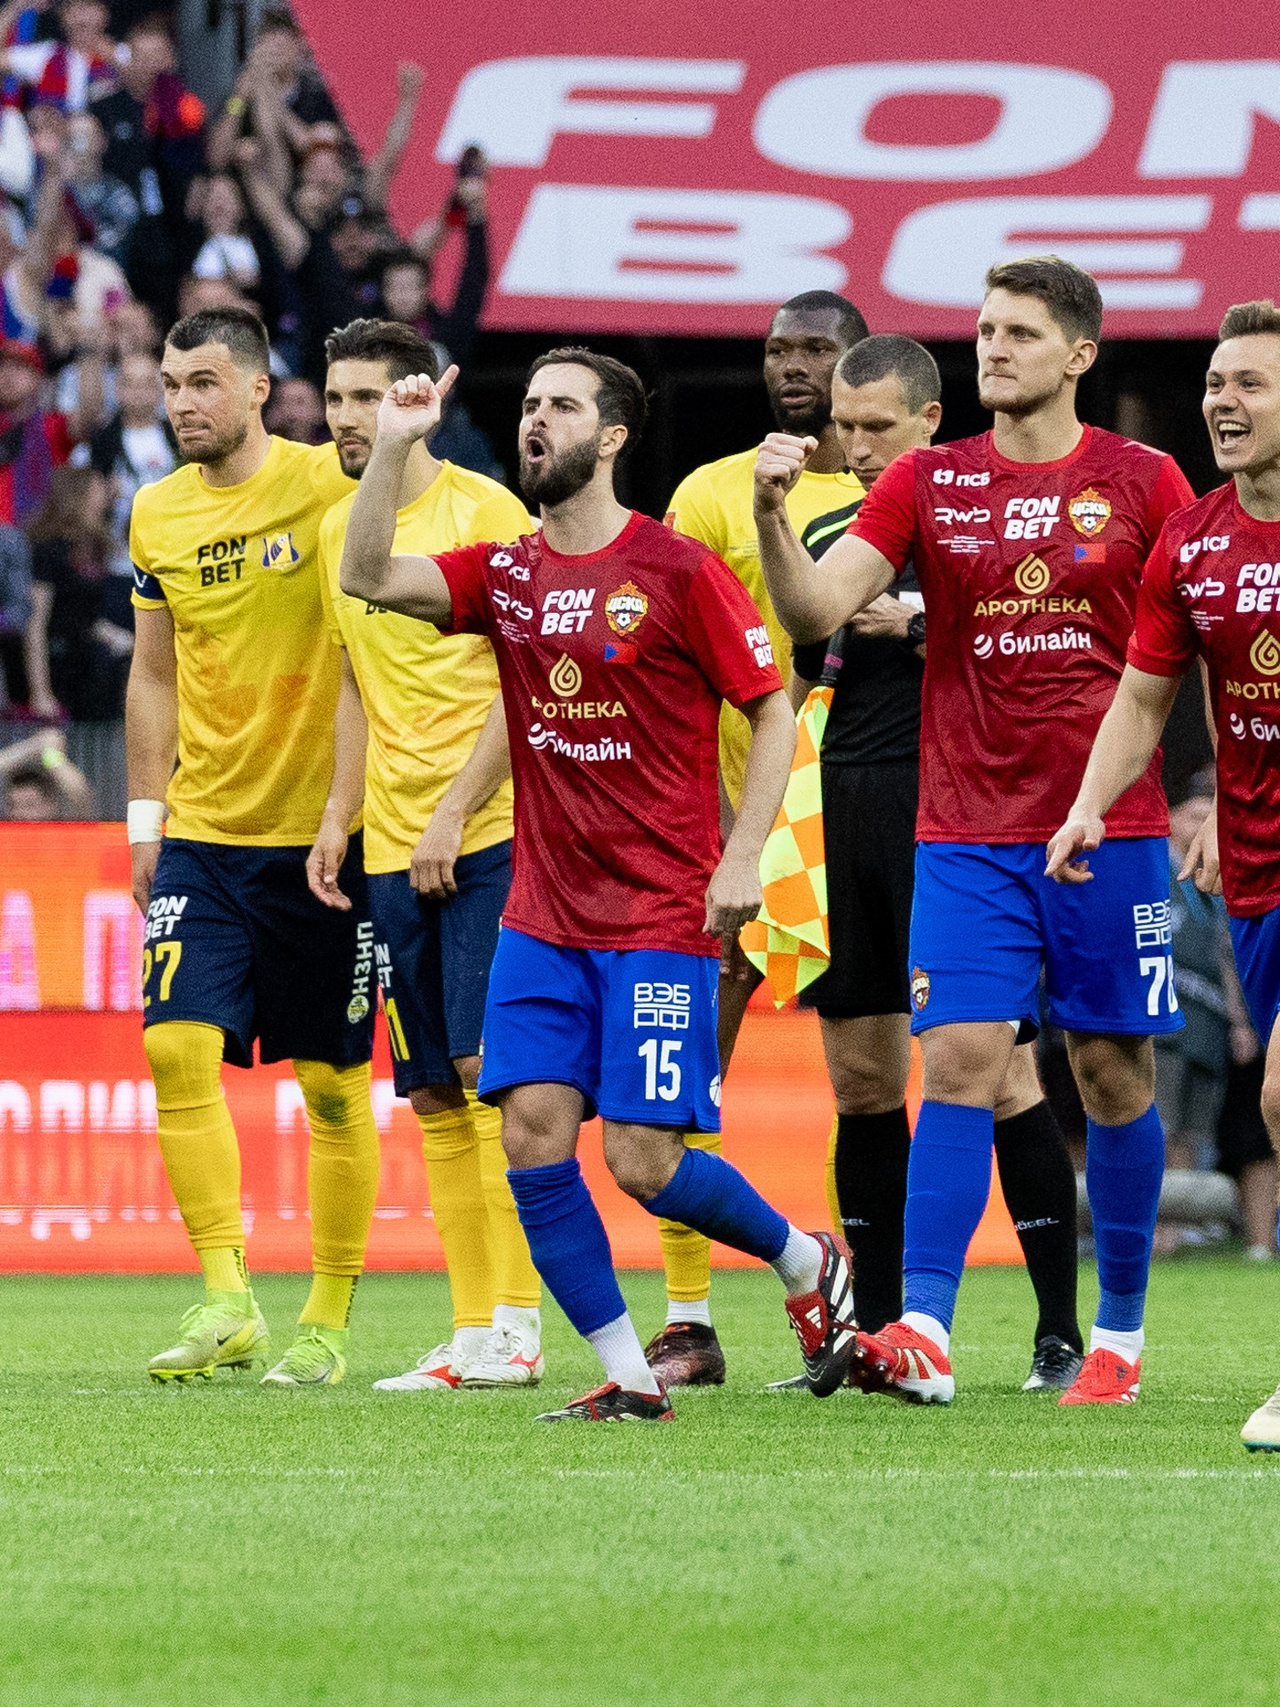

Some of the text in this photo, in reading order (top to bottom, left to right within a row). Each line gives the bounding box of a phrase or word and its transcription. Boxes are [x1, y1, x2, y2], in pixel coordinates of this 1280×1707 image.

[1004, 496, 1060, 518] FON
[1004, 517, 1060, 540] BET
[197, 536, 247, 565] FON
[201, 558, 245, 587] BET
[542, 588, 596, 612] FON
[973, 598, 1092, 616] APOTHEKA
[541, 610, 593, 635] BET
[999, 628, 1092, 655] билайн
[634, 983, 691, 1004] ВЭБ
[638, 1038, 683, 1101] 15
